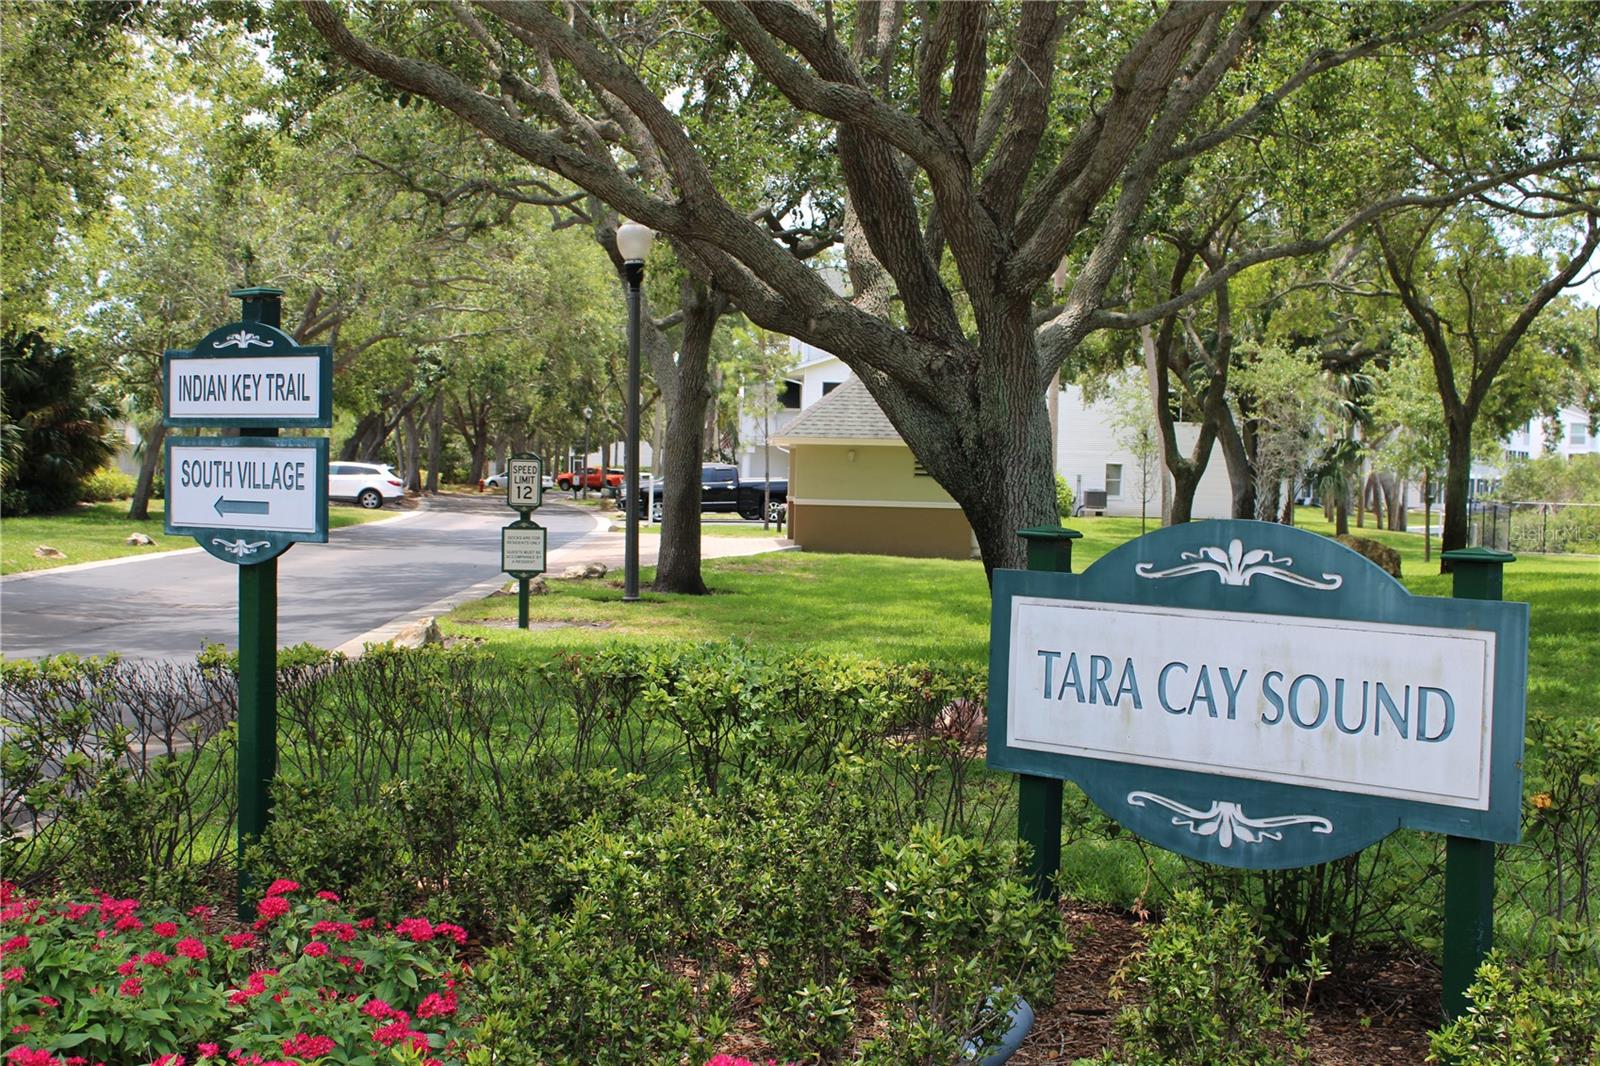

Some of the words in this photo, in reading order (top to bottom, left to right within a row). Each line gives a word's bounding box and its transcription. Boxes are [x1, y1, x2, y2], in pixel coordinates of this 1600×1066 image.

[178, 375, 227, 402] INDIAN
[232, 374, 262, 402] KEY
[266, 373, 311, 402] TRAIL
[181, 459, 233, 488] SOUTH
[237, 461, 305, 491] VILLAGE
[513, 465, 538, 475] SPEED
[514, 475, 536, 485] LIMIT
[516, 485, 533, 500] 12
[1037, 650, 1143, 710] TARA
[1157, 661, 1247, 720] CAY
[1261, 671, 1456, 743] SOUND
